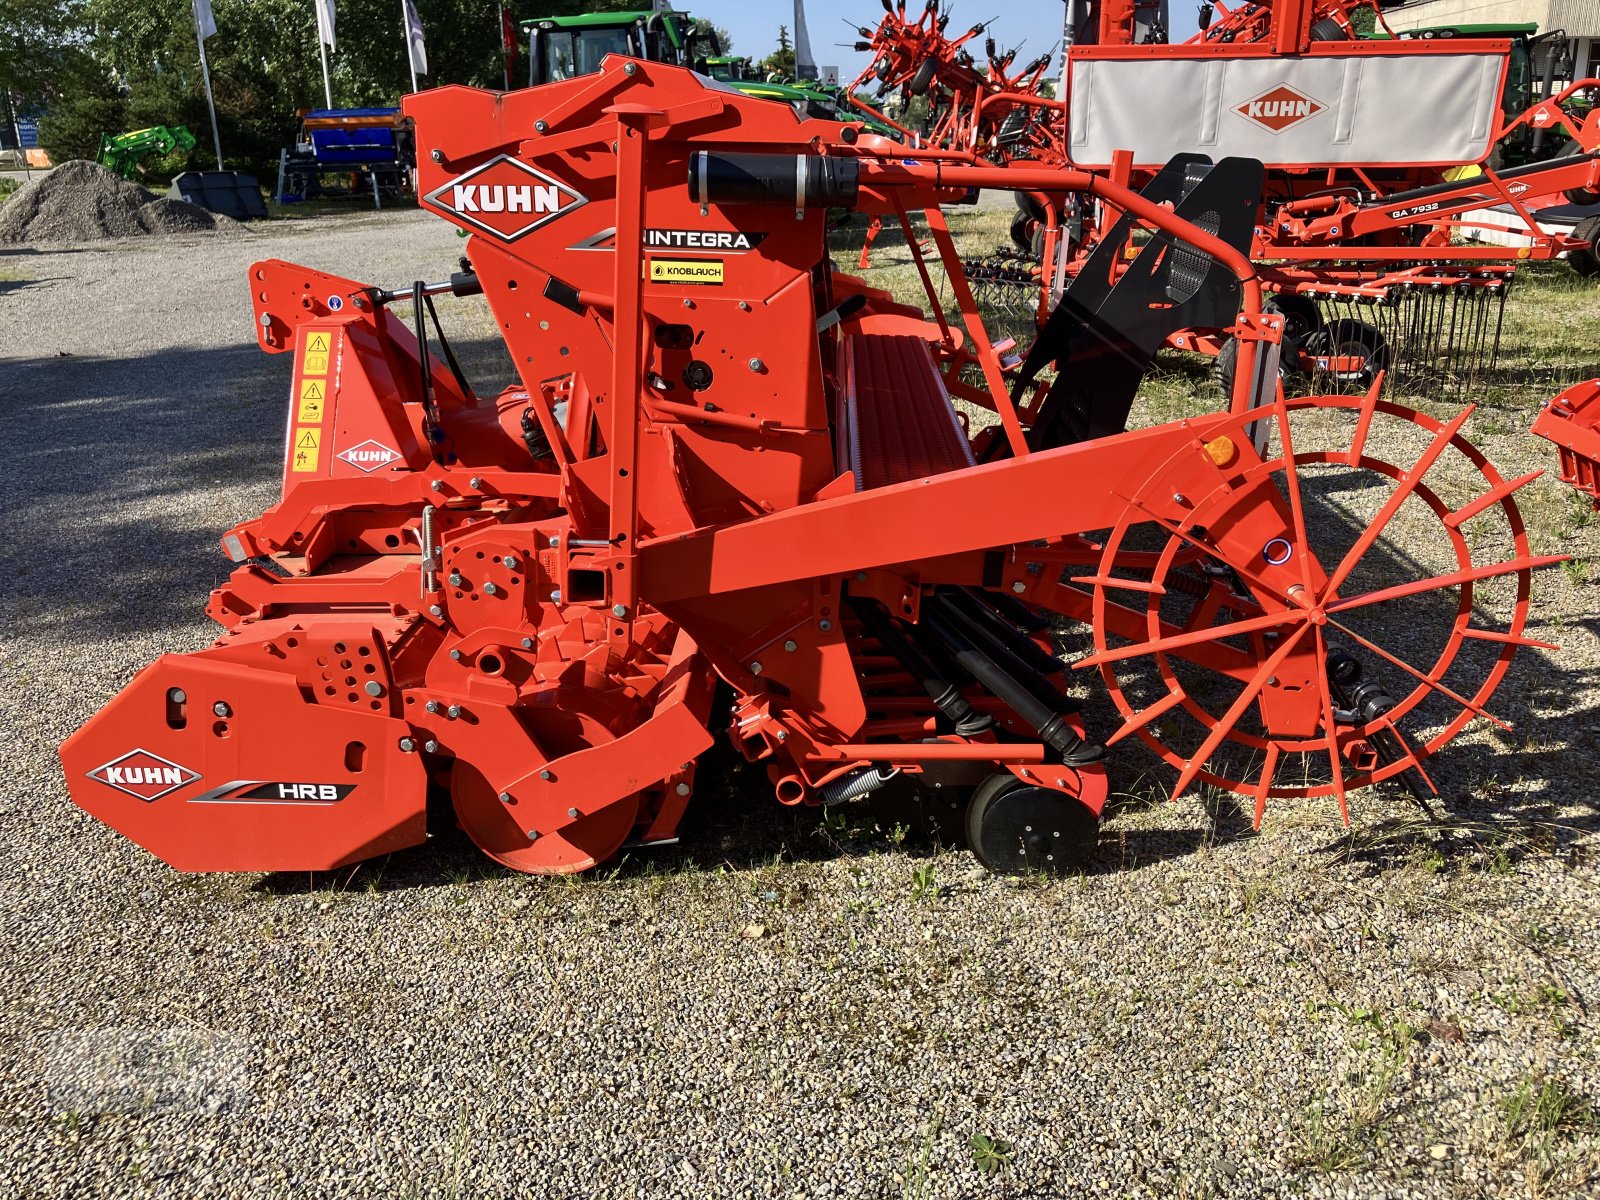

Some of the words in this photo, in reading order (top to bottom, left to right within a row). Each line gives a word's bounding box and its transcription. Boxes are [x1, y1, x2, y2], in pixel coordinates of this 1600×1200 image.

[1247, 100, 1312, 118] KUHN
[1508, 185, 1527, 194] UHN
[453, 184, 560, 213] KUHN
[1392, 209, 1409, 218] GA
[1411, 202, 1439, 214] 7932
[650, 230, 750, 248] INTEGRA
[667, 267, 721, 277] KNOBLAUCH
[348, 450, 392, 462] KUHN
[106, 767, 182, 785] KUHN
[278, 783, 338, 800] HRB
